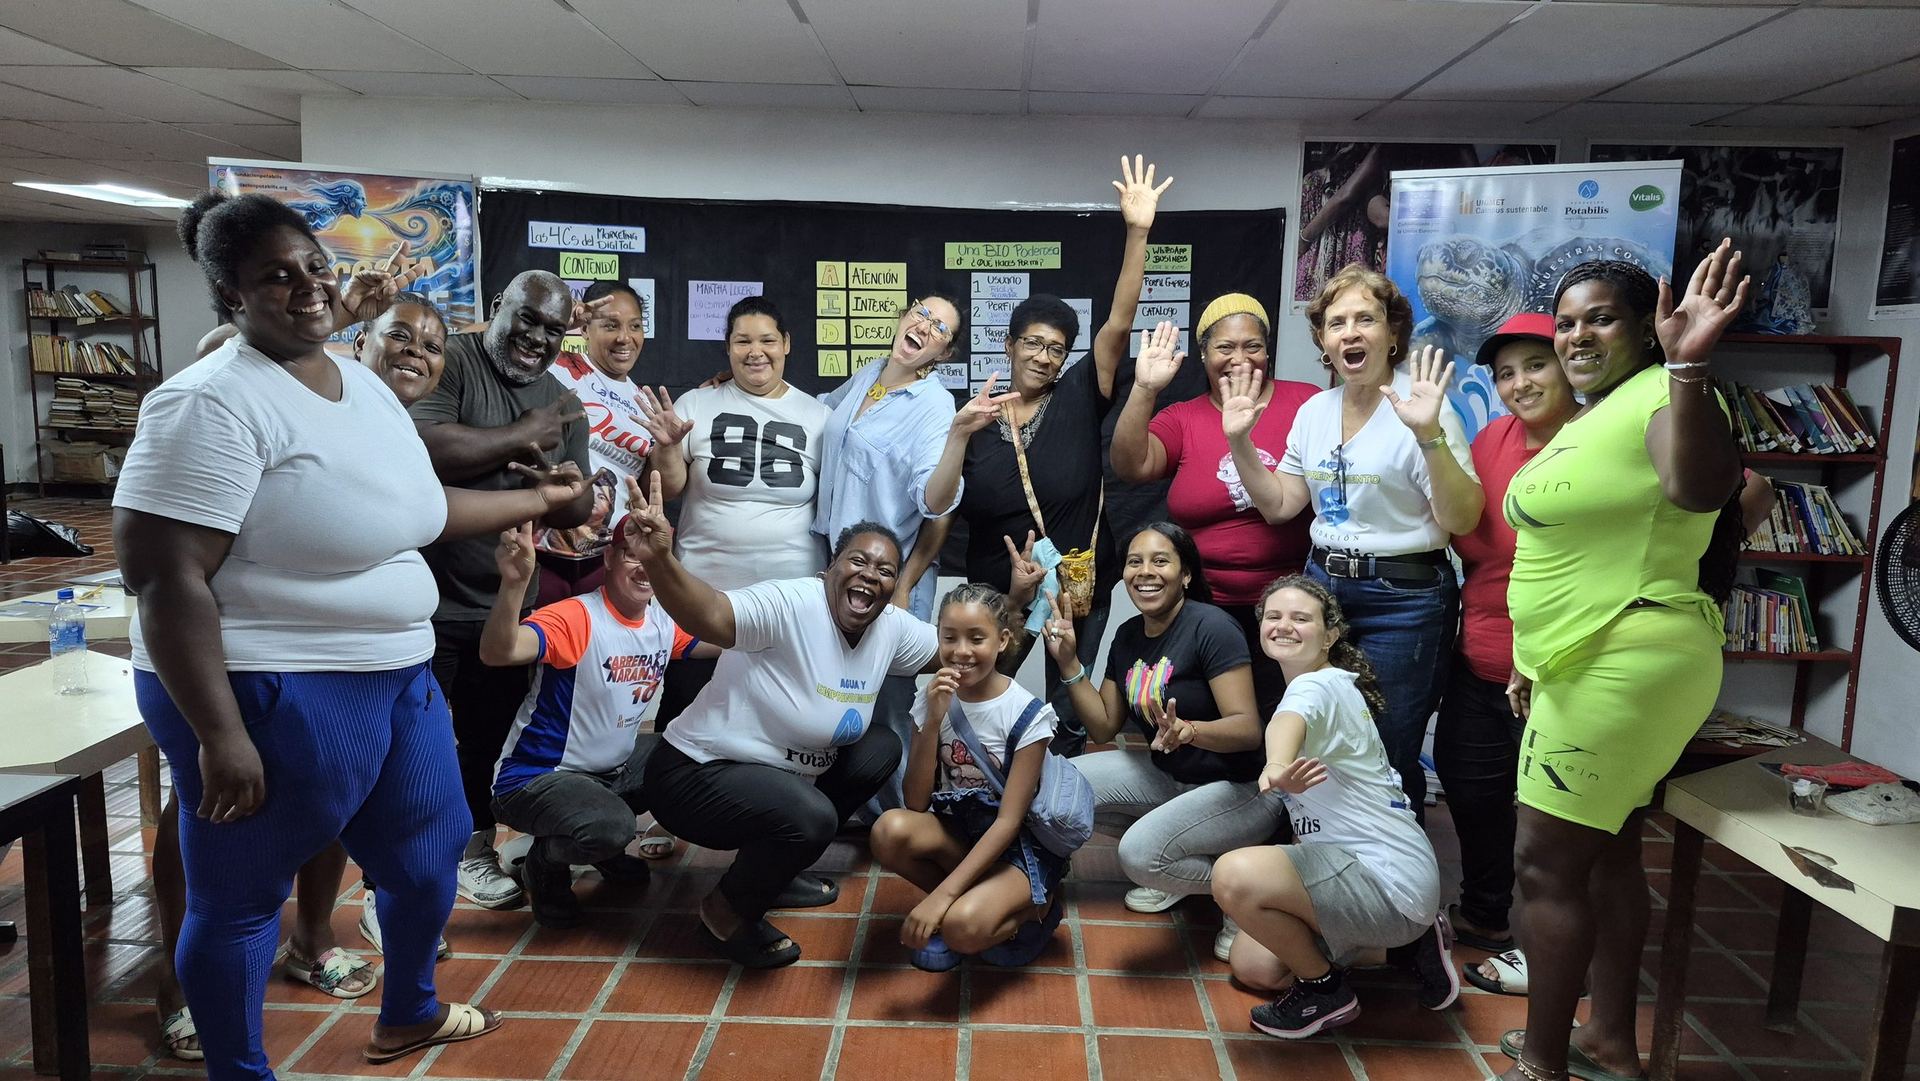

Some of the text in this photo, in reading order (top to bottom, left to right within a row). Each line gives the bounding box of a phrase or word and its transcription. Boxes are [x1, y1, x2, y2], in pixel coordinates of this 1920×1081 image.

[1632, 193, 1661, 202] Vitalis
[1506, 205, 1549, 214] sustentable
[1565, 206, 1609, 216] Potabilis
[581, 234, 595, 247] del
[957, 243, 1060, 258] Una BIO Poderosa
[851, 267, 899, 286] ATENCIÓN
[972, 279, 982, 294] 1
[972, 305, 981, 319] 2
[972, 333, 981, 346] 3
[972, 359, 982, 373] 4
[840, 678, 867, 691] AGUA Y
